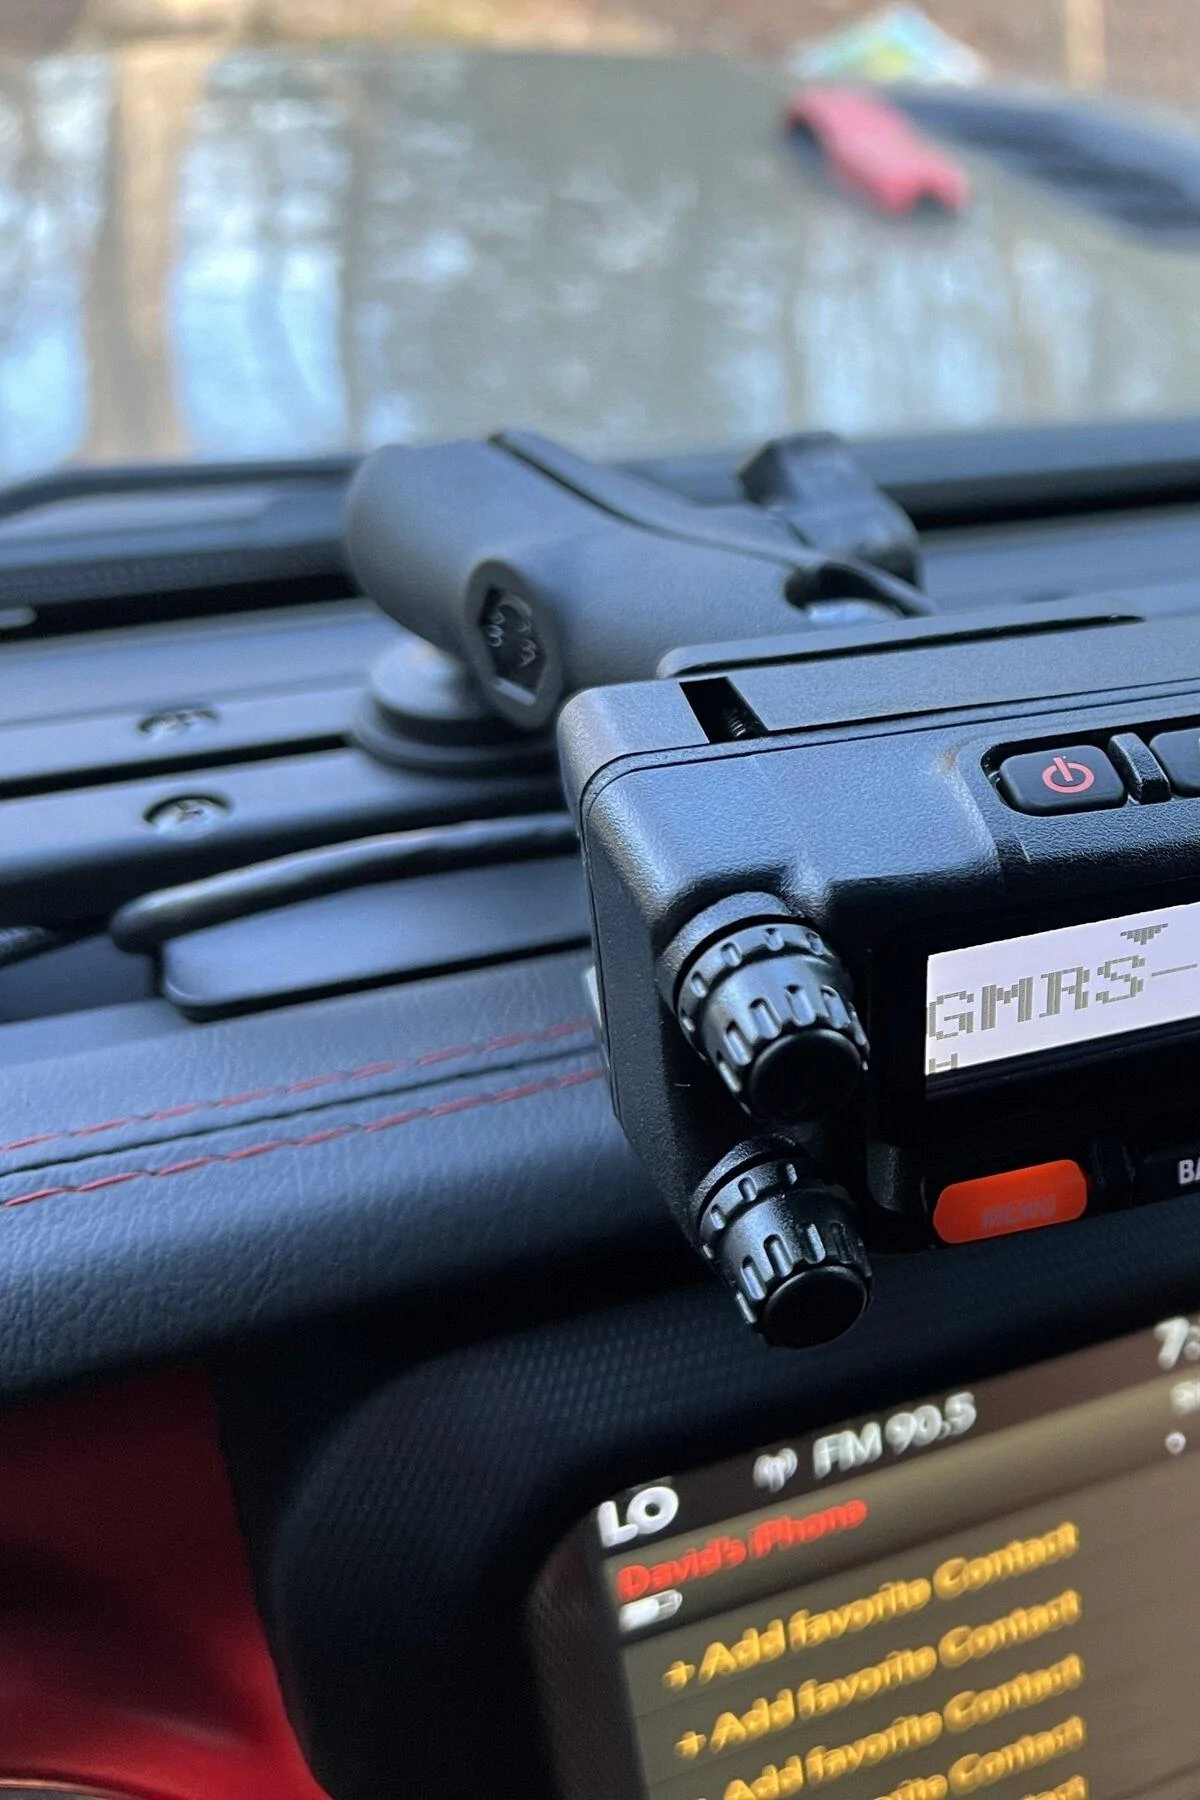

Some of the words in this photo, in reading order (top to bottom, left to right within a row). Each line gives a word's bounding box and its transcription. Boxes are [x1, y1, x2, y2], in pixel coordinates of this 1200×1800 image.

[812, 1421, 883, 1480] FM
[885, 1391, 977, 1455] 90.5
[597, 1485, 679, 1548] LO
